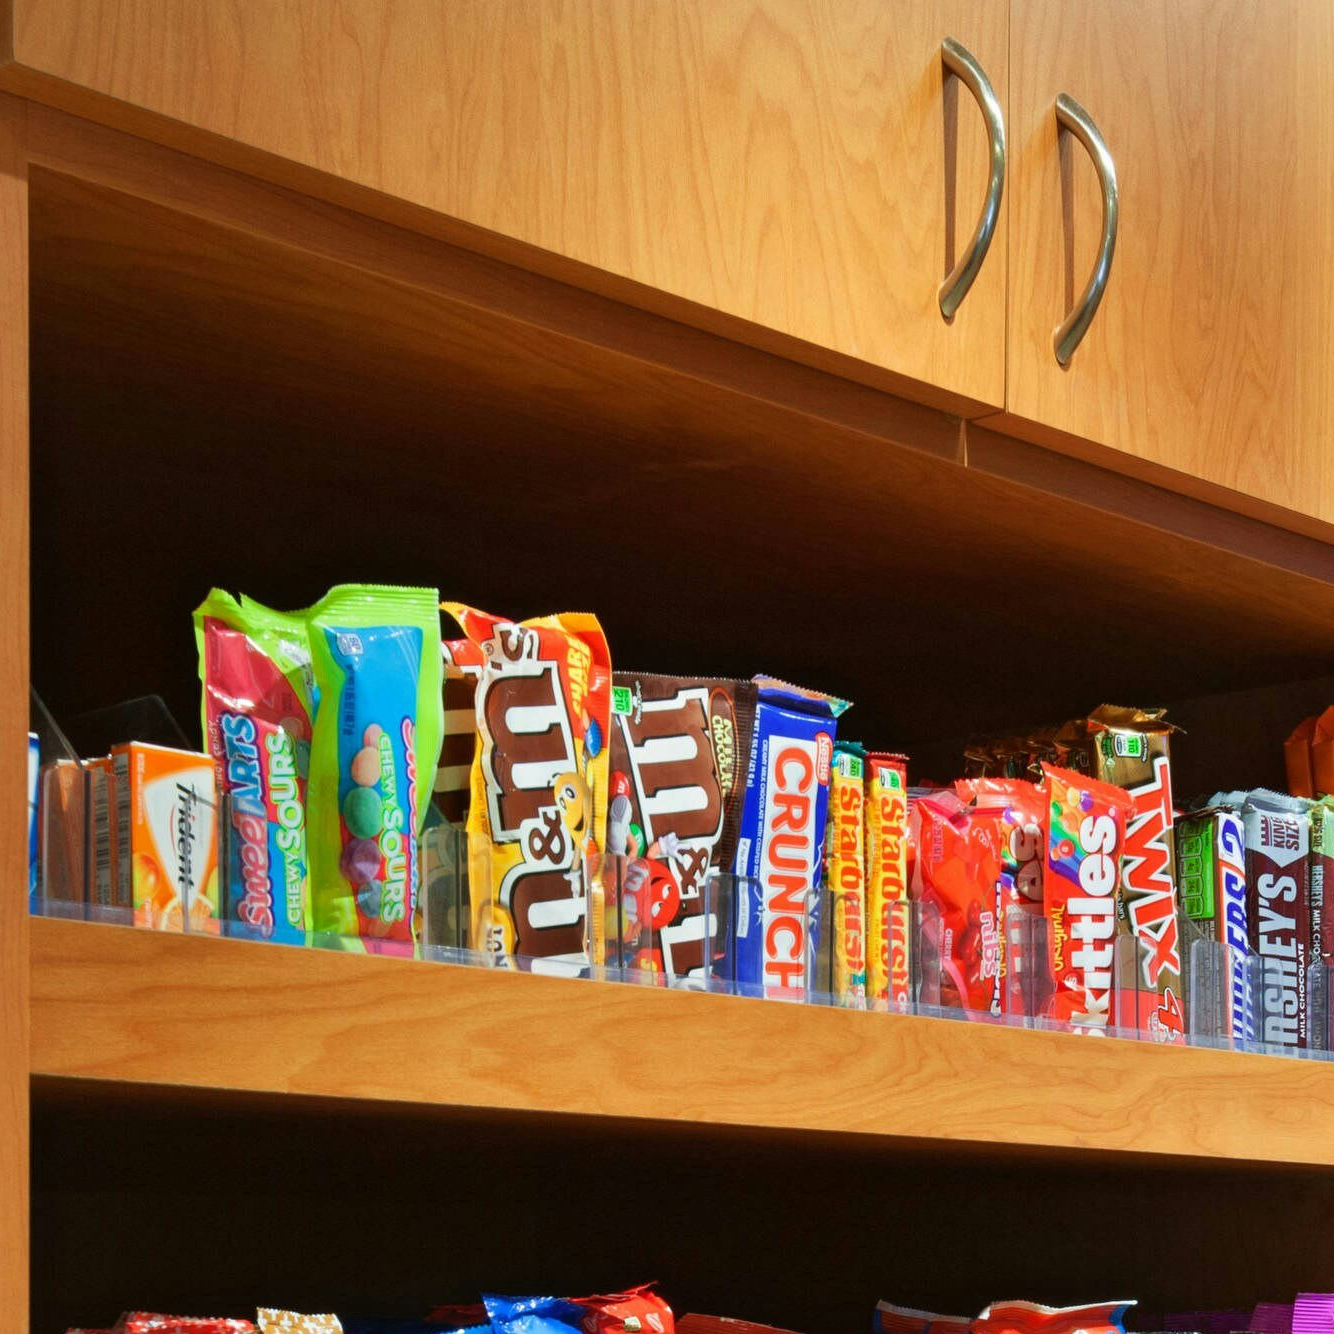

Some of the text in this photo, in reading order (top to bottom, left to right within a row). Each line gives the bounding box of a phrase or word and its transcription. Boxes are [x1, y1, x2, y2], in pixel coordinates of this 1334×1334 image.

[176, 782, 197, 889] Trident
[266, 733, 307, 927] CHEWY SOURS
[379, 733, 405, 923] CHEWY SOURS
[757, 783, 766, 820] CHOCOLATE
[764, 746, 815, 990] CRUNCH
[841, 785, 864, 970] Starburst
[881, 796, 908, 985] Starburst
[1121, 757, 1180, 988] TWIX
[1273, 816, 1286, 849] KING
[979, 911, 998, 980] nibs
[1258, 873, 1299, 1046] RSHEY'S
[1311, 865, 1324, 931] HERSHEY'S MILK
